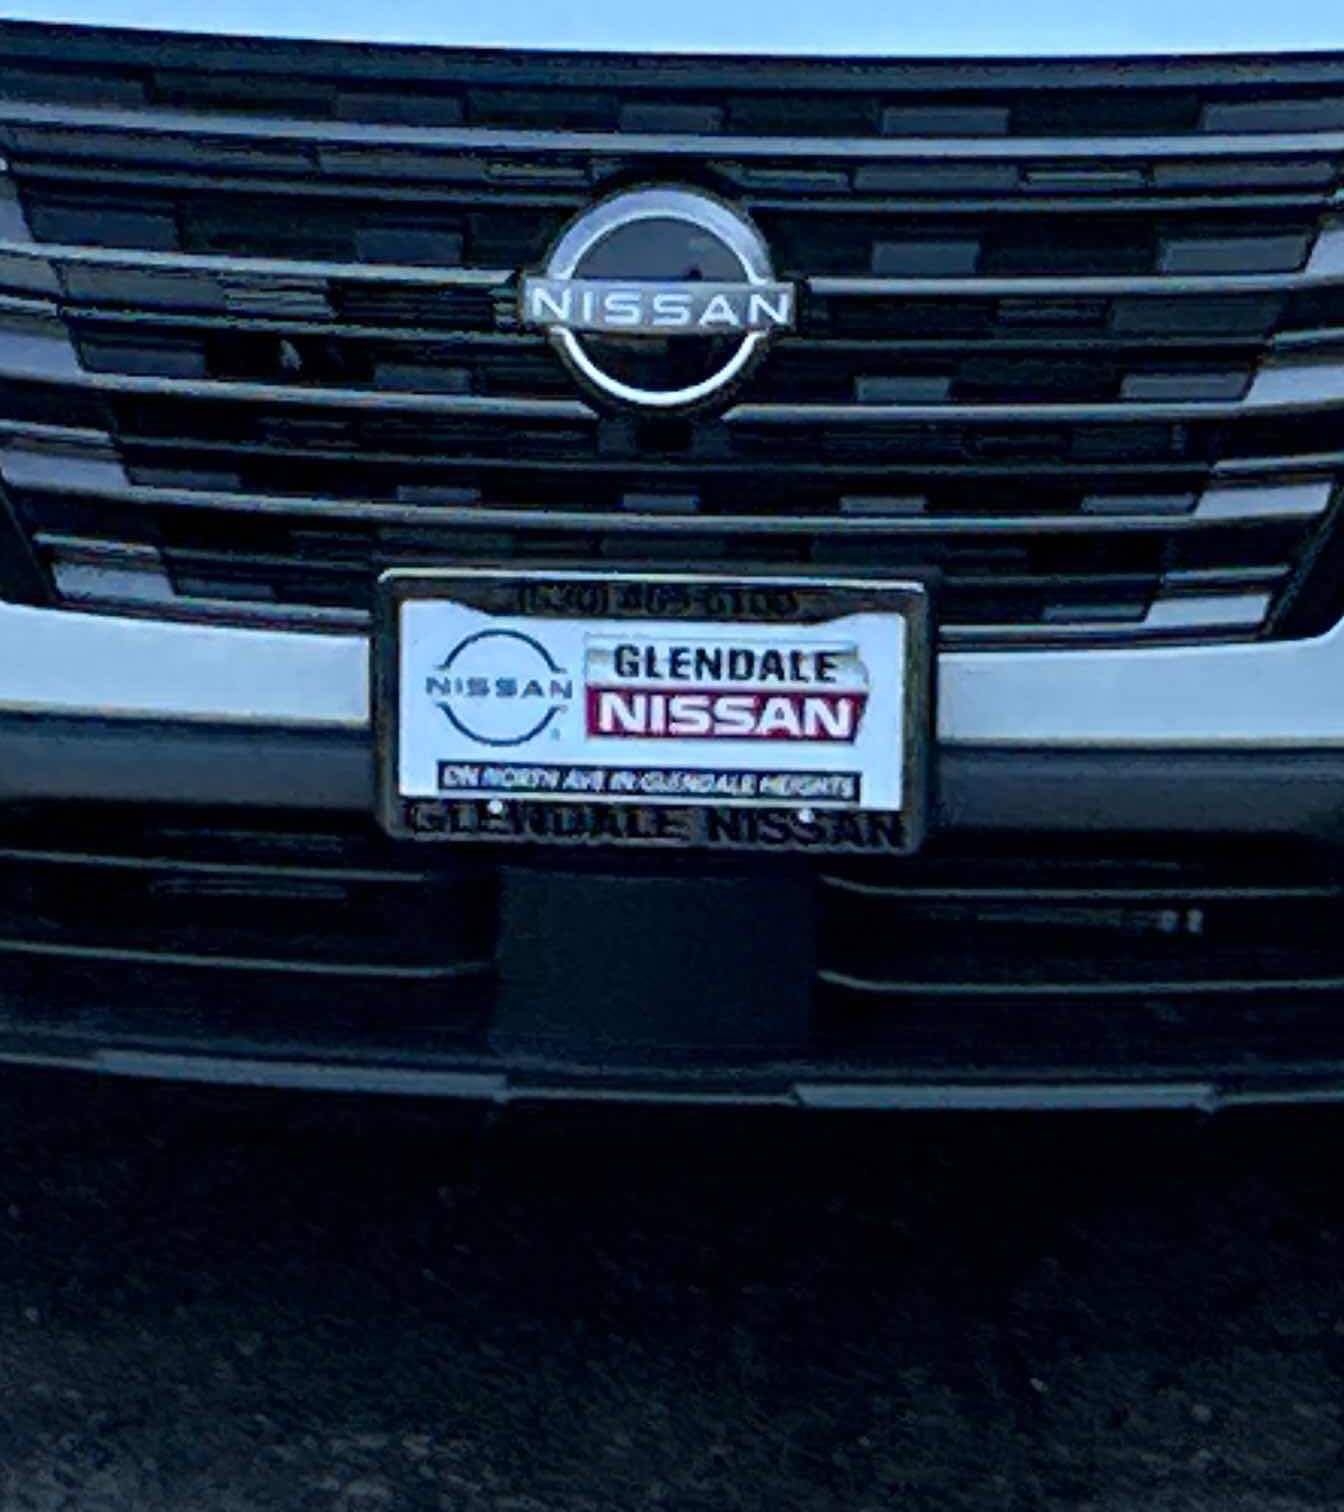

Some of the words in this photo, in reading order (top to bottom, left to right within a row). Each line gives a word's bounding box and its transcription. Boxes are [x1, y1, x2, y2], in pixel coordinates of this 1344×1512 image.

[531, 287, 790, 327] NISSAN
[613, 643, 839, 684] GLENDALE
[425, 676, 574, 700] NISSAN
[597, 691, 853, 739] NISSAN
[407, 802, 691, 844] GLENDALE
[709, 807, 907, 850] NISSAN
